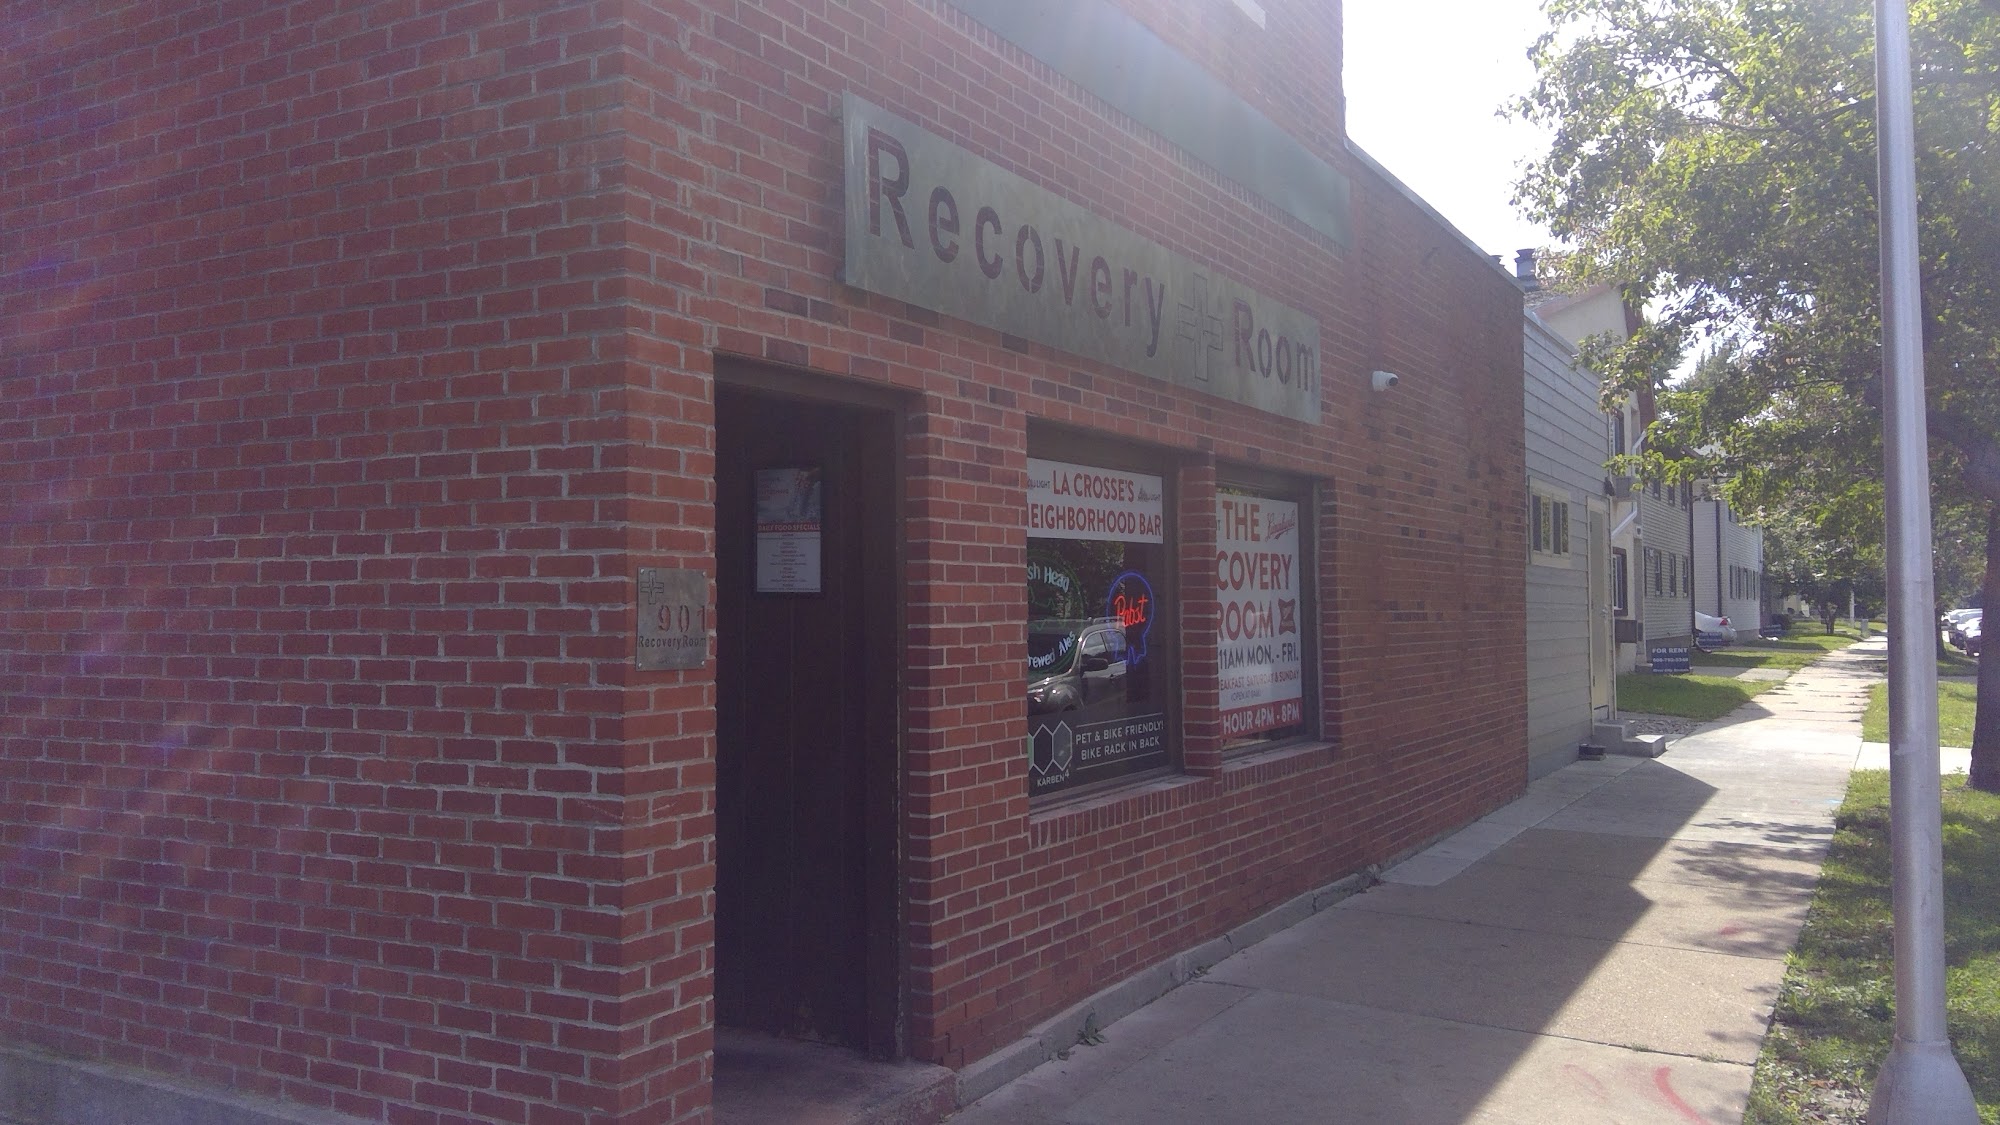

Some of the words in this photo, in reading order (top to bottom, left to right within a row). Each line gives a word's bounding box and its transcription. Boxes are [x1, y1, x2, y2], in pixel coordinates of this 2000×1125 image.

[867, 125, 1166, 358] Recovery
[1233, 297, 1315, 392] Room
[1053, 470, 1070, 496] LA
[1073, 472, 1134, 503] CROSSE'S
[792, 523, 820, 531] SPECIALS
[1139, 512, 1161, 537] BAR
[1222, 500, 1260, 542] THE
[1216, 550, 1292, 591] COVERY
[657, 604, 706, 633] 901
[1113, 594, 1148, 629] Pabst
[1219, 645, 1244, 670] 11AM
[1247, 644, 1274, 666] MON.
[1281, 642, 1299, 662] FRI.
[1076, 732, 1092, 745] PET
[1094, 730, 1101, 742] &
[1103, 725, 1122, 740] BIKE
[1125, 720, 1164, 737] FRIENDLY!
[1222, 710, 1253, 735] HOUR
[1255, 706, 1275, 728] 4PM
[1281, 702, 1299, 723] 8PM
[1081, 746, 1101, 761] BIKE
[1104, 742, 1126, 756] RACK
[1128, 740, 1137, 750] IN
[1140, 736, 1160, 748] BACK
